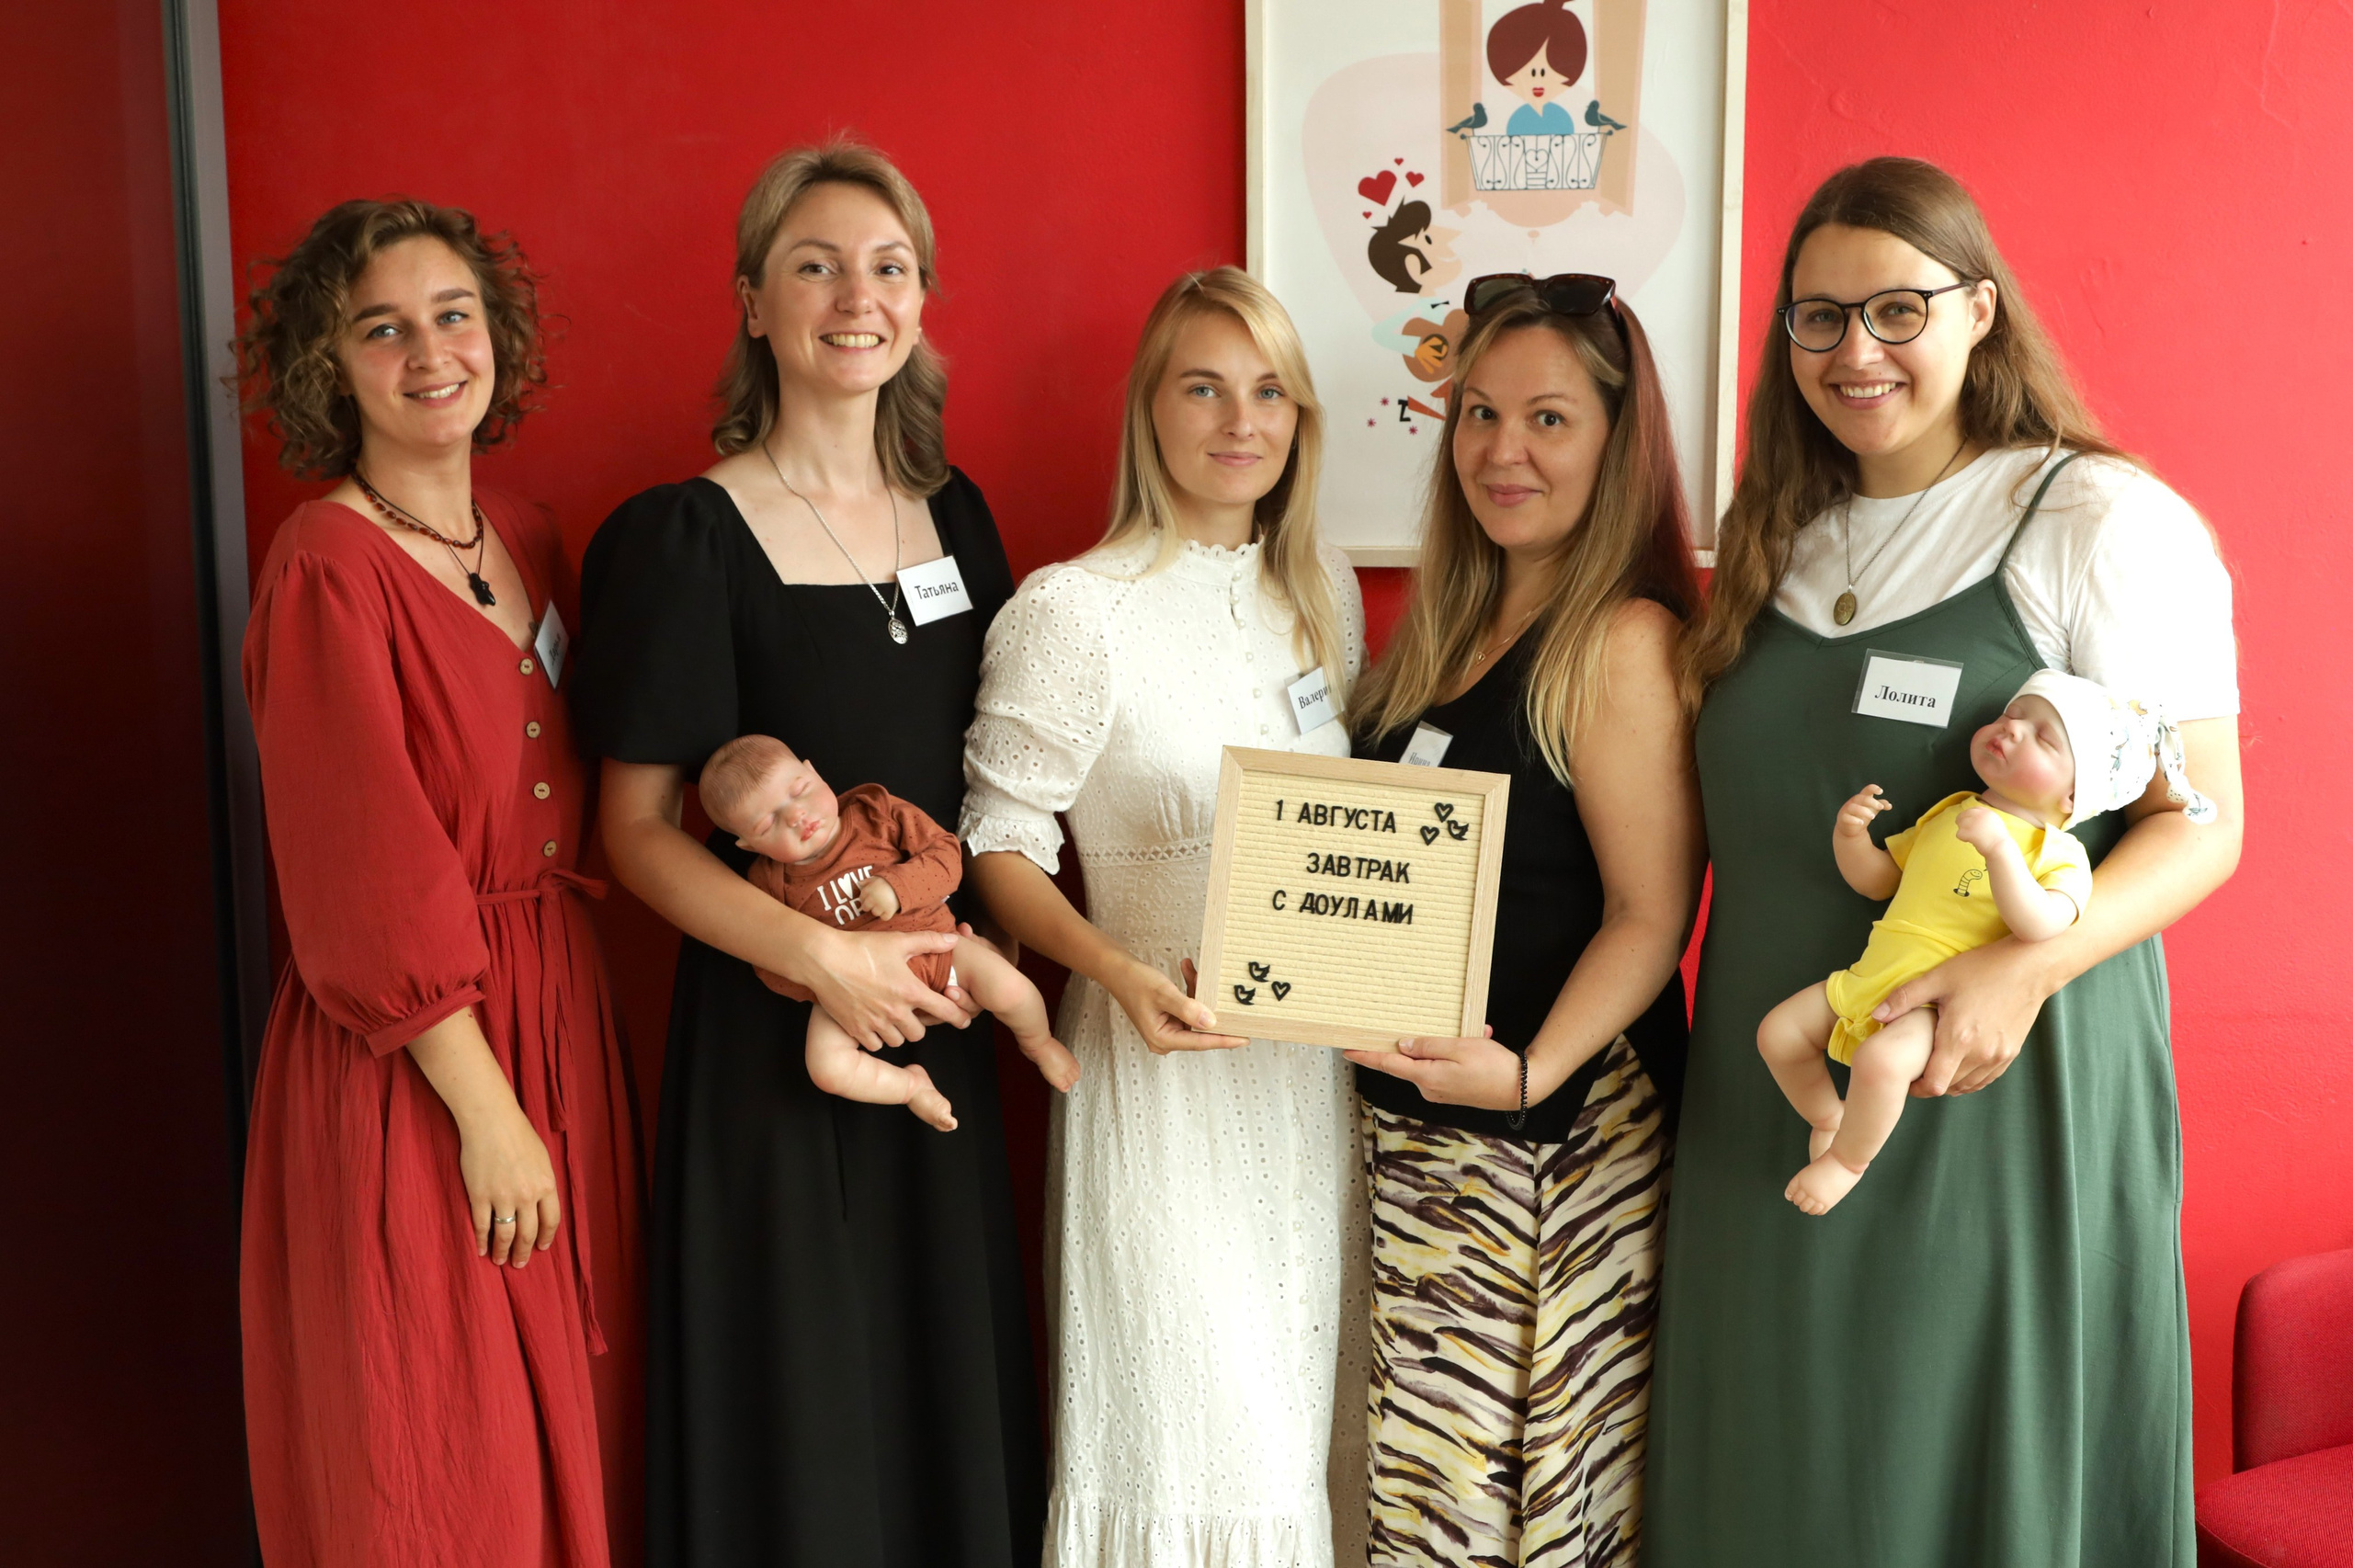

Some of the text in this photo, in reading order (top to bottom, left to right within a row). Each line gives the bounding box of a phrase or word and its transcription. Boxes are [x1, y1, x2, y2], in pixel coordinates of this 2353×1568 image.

[914, 582, 959, 599] Татьяна
[1298, 684, 1332, 710] Валери
[1874, 685, 1937, 709] Лолита
[1276, 800, 1397, 834] 1 АВГУСТА
[1306, 852, 1410, 884] ЗАВТРАК
[817, 885, 832, 911] I
[1272, 889, 1414, 925] С ДОУЛАМИ
